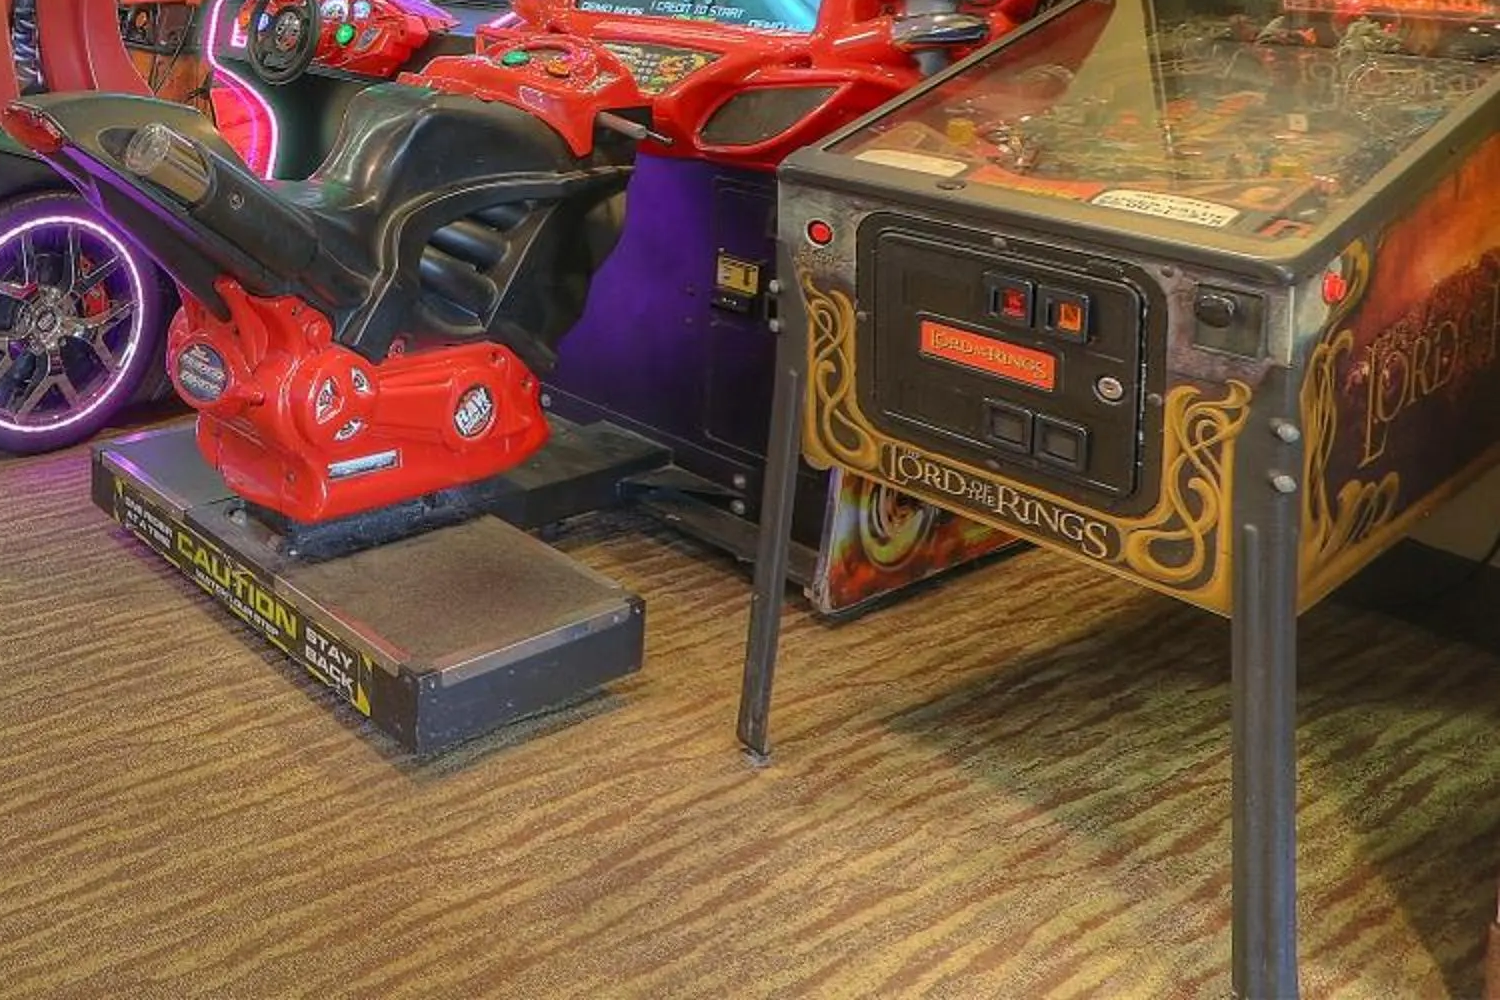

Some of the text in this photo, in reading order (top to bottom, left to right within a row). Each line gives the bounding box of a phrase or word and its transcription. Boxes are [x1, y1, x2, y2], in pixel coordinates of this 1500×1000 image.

[580, 1, 613, 13] DEMO
[656, 2, 691, 16] CREDIT
[692, 5, 709, 16] TO
[709, 6, 746, 20] START
[882, 442, 967, 496] LORD
[971, 480, 994, 495] OF
[995, 485, 1108, 559] RINGS
[177, 530, 297, 641] CAUTION
[305, 644, 355, 702] BACK
[306, 625, 353, 670] STAY
